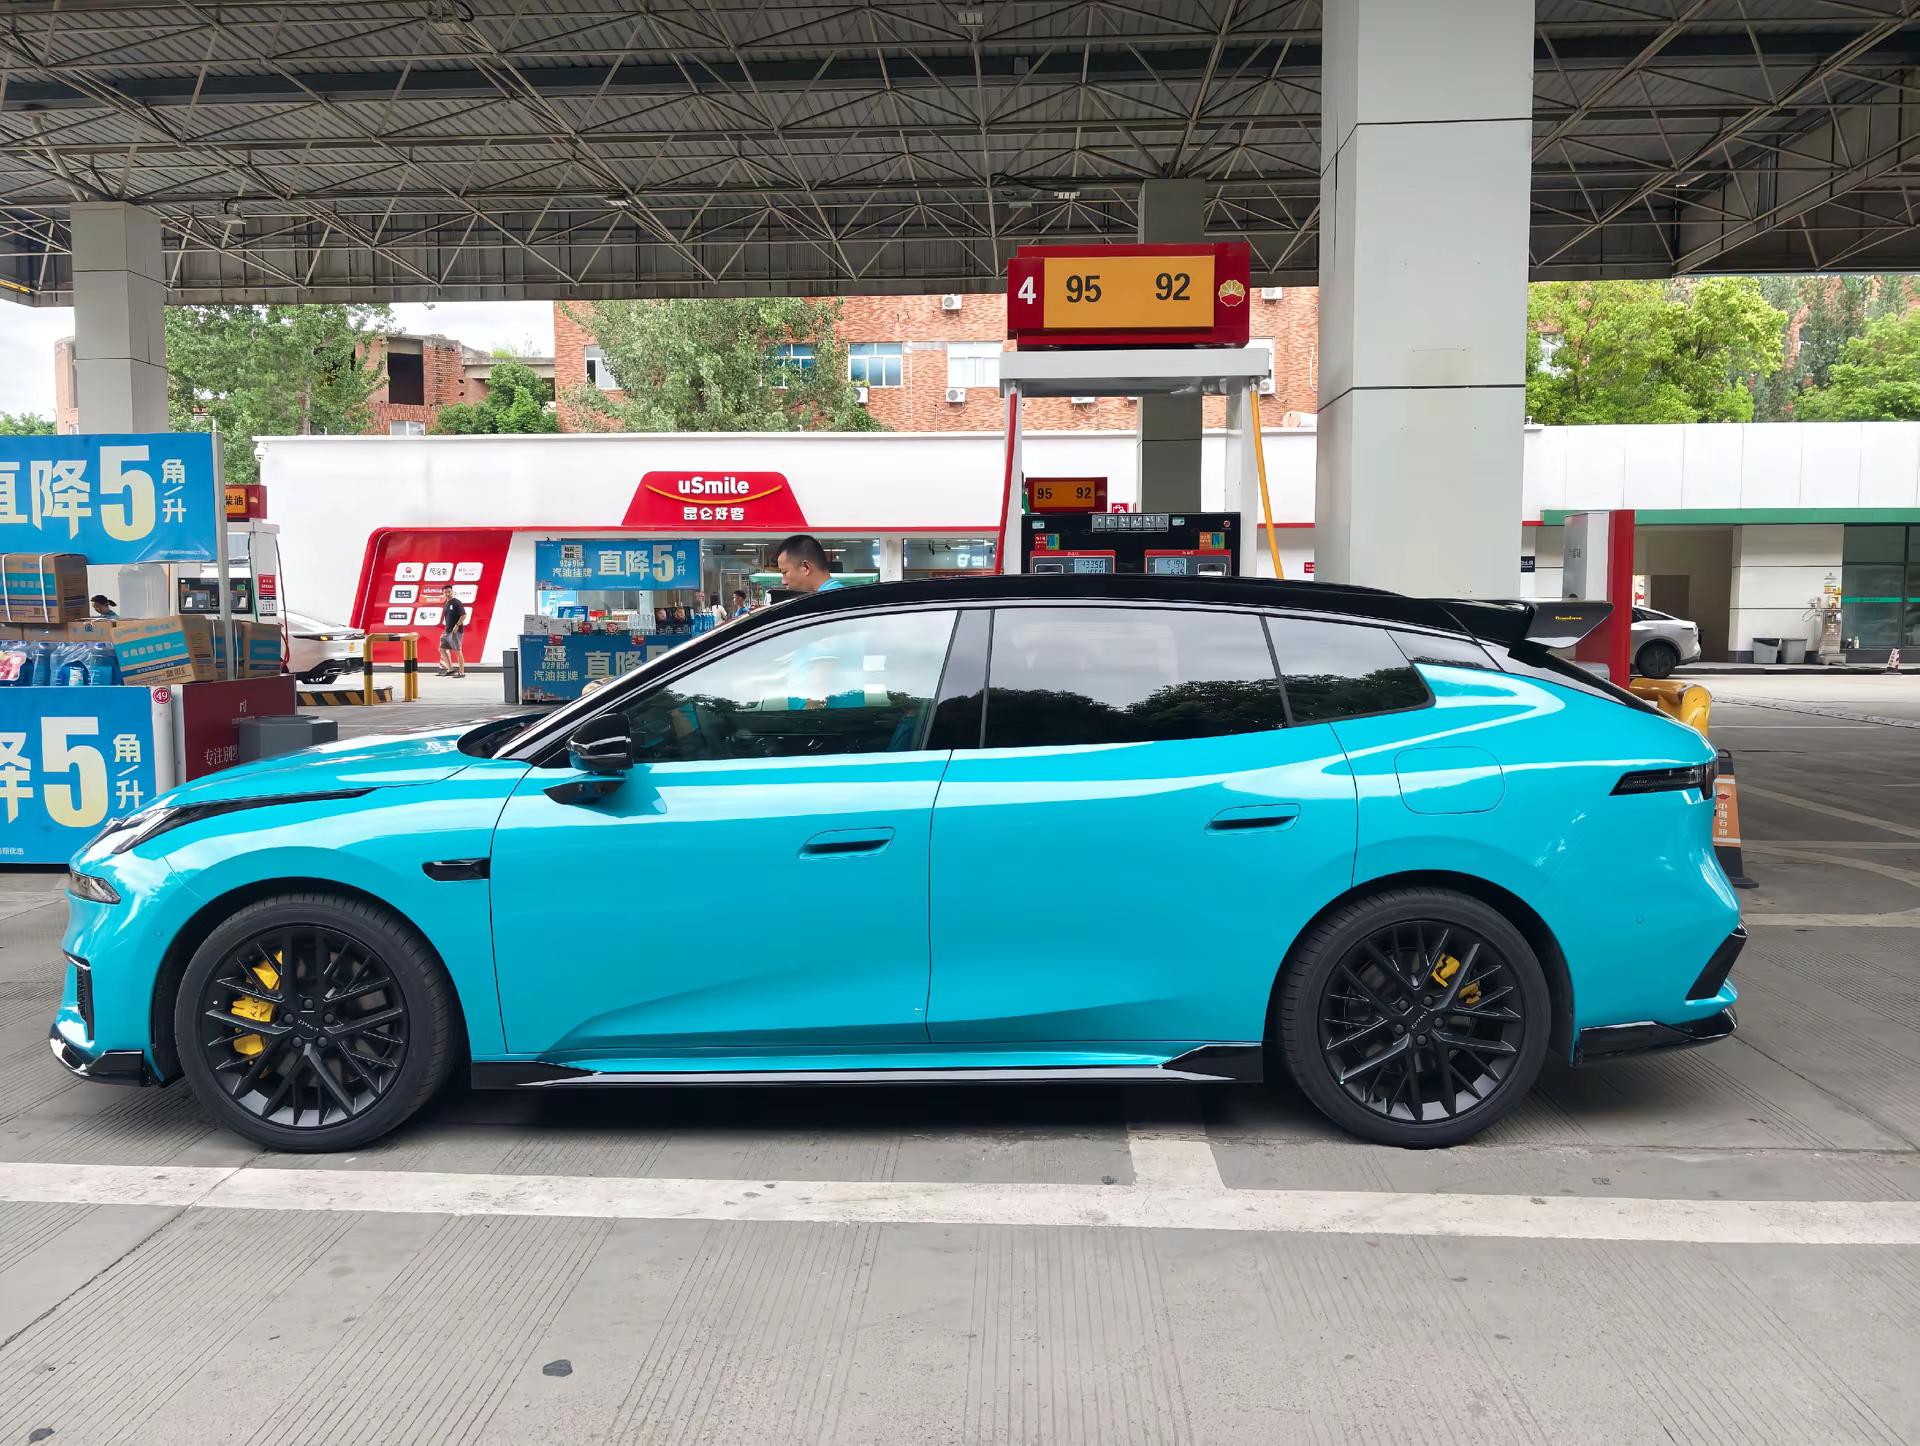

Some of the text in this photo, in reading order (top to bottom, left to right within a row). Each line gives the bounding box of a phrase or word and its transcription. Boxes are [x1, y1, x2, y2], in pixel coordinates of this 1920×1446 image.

[1017, 276, 1036, 304] 4
[1065, 272, 1190, 303] 95 92
[678, 476, 749, 494] uSmile
[1037, 486, 1092, 500] 95 92
[683, 507, 744, 521] 昆仑好客
[534, 671, 578, 681] 汽油挂牌
